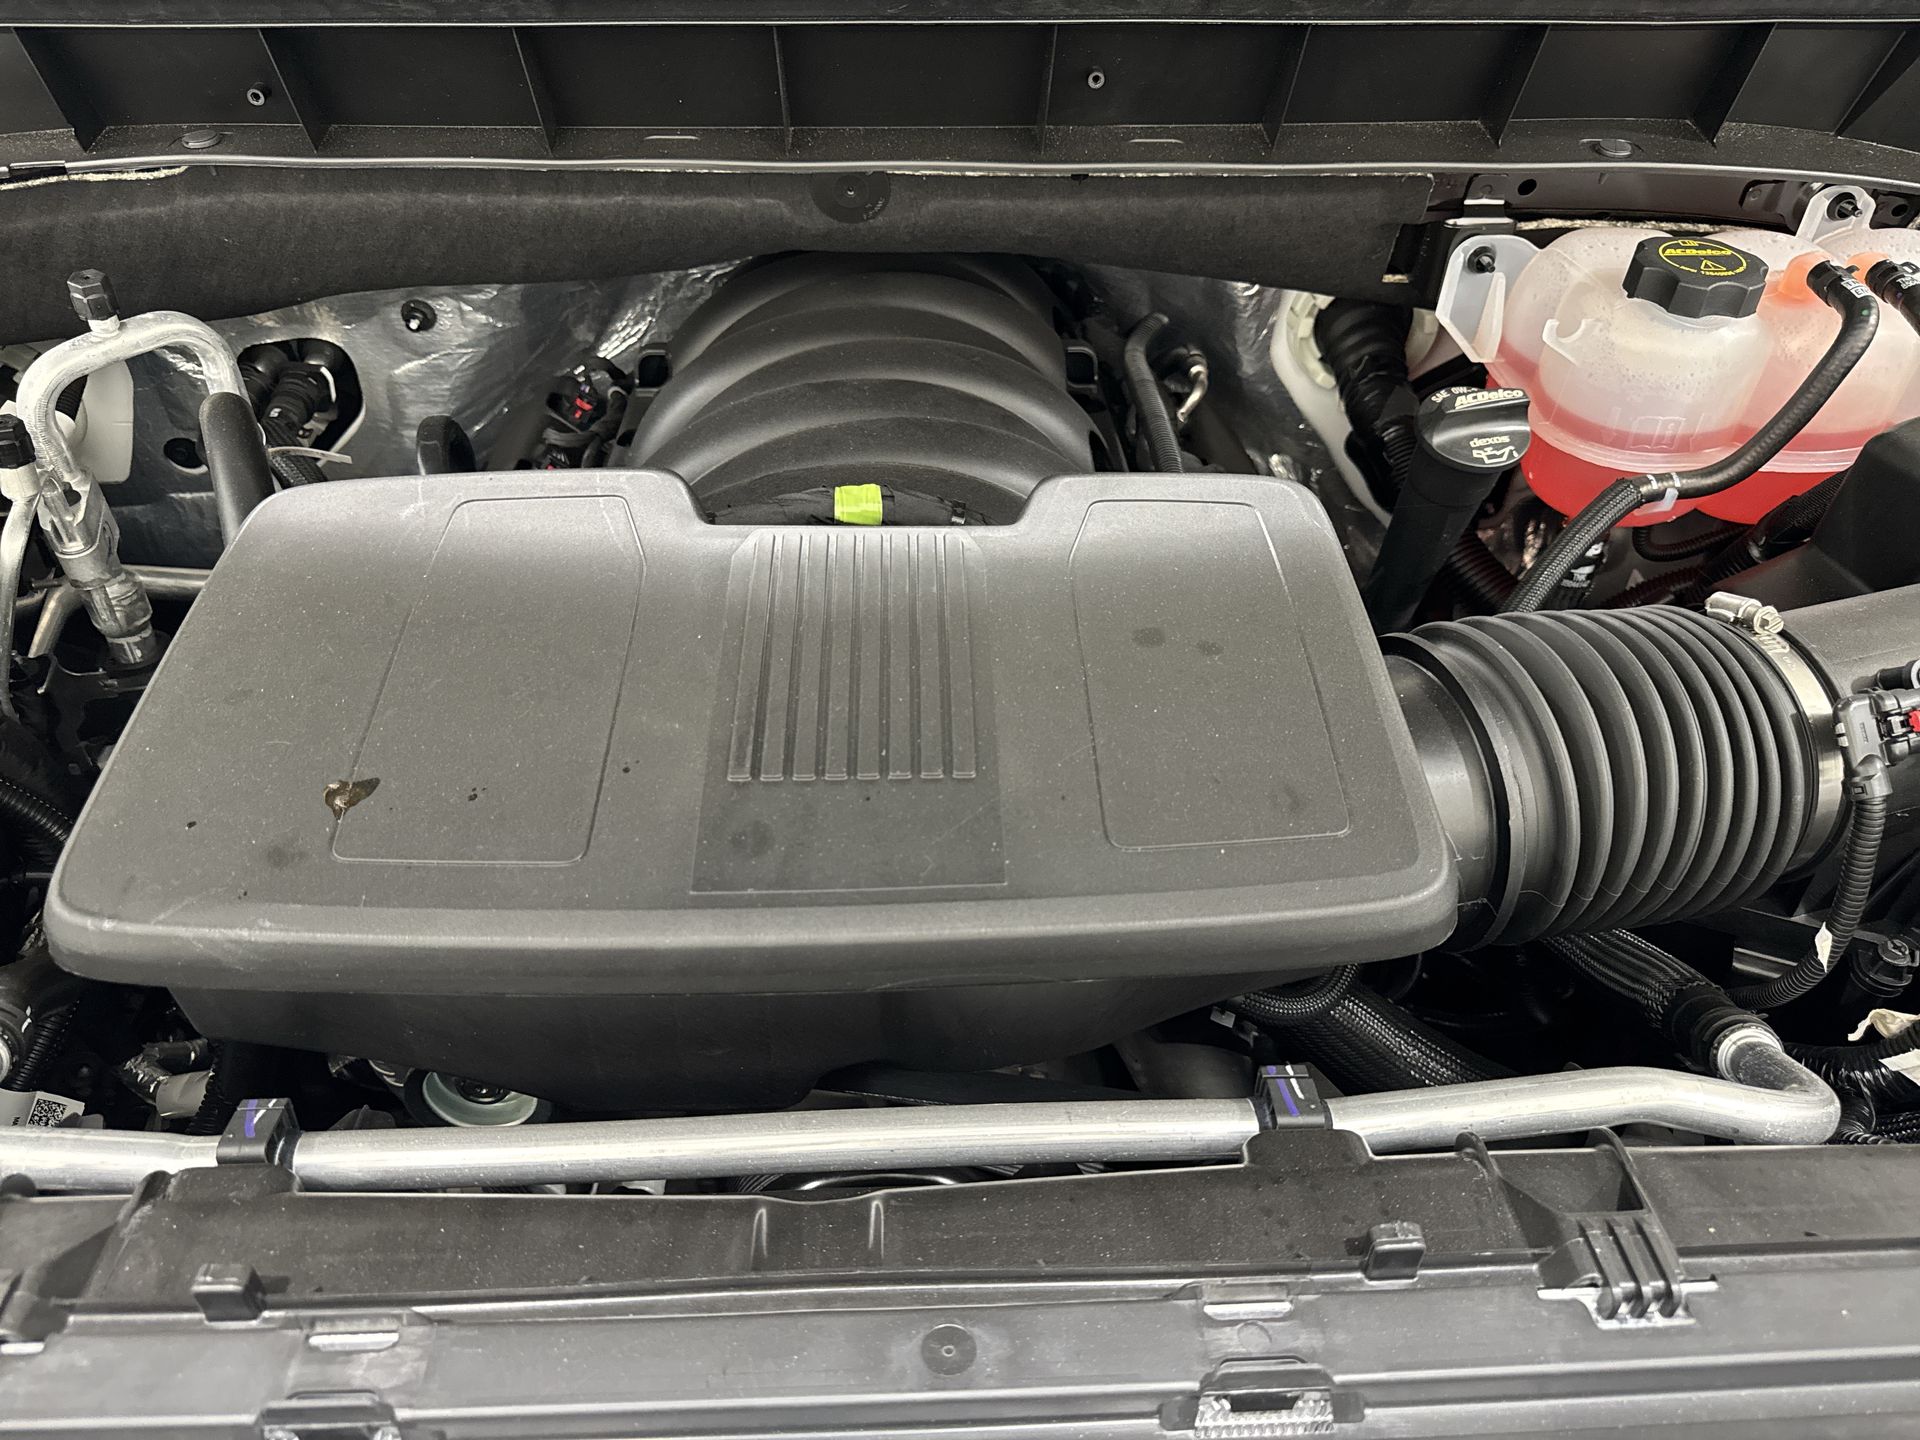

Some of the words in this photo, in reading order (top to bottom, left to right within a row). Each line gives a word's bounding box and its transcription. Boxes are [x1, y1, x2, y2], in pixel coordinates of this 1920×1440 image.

[1431, 390, 1450, 403] SAE
[1454, 388, 1524, 410] ACDelco
[1469, 435, 1511, 448] dexos
